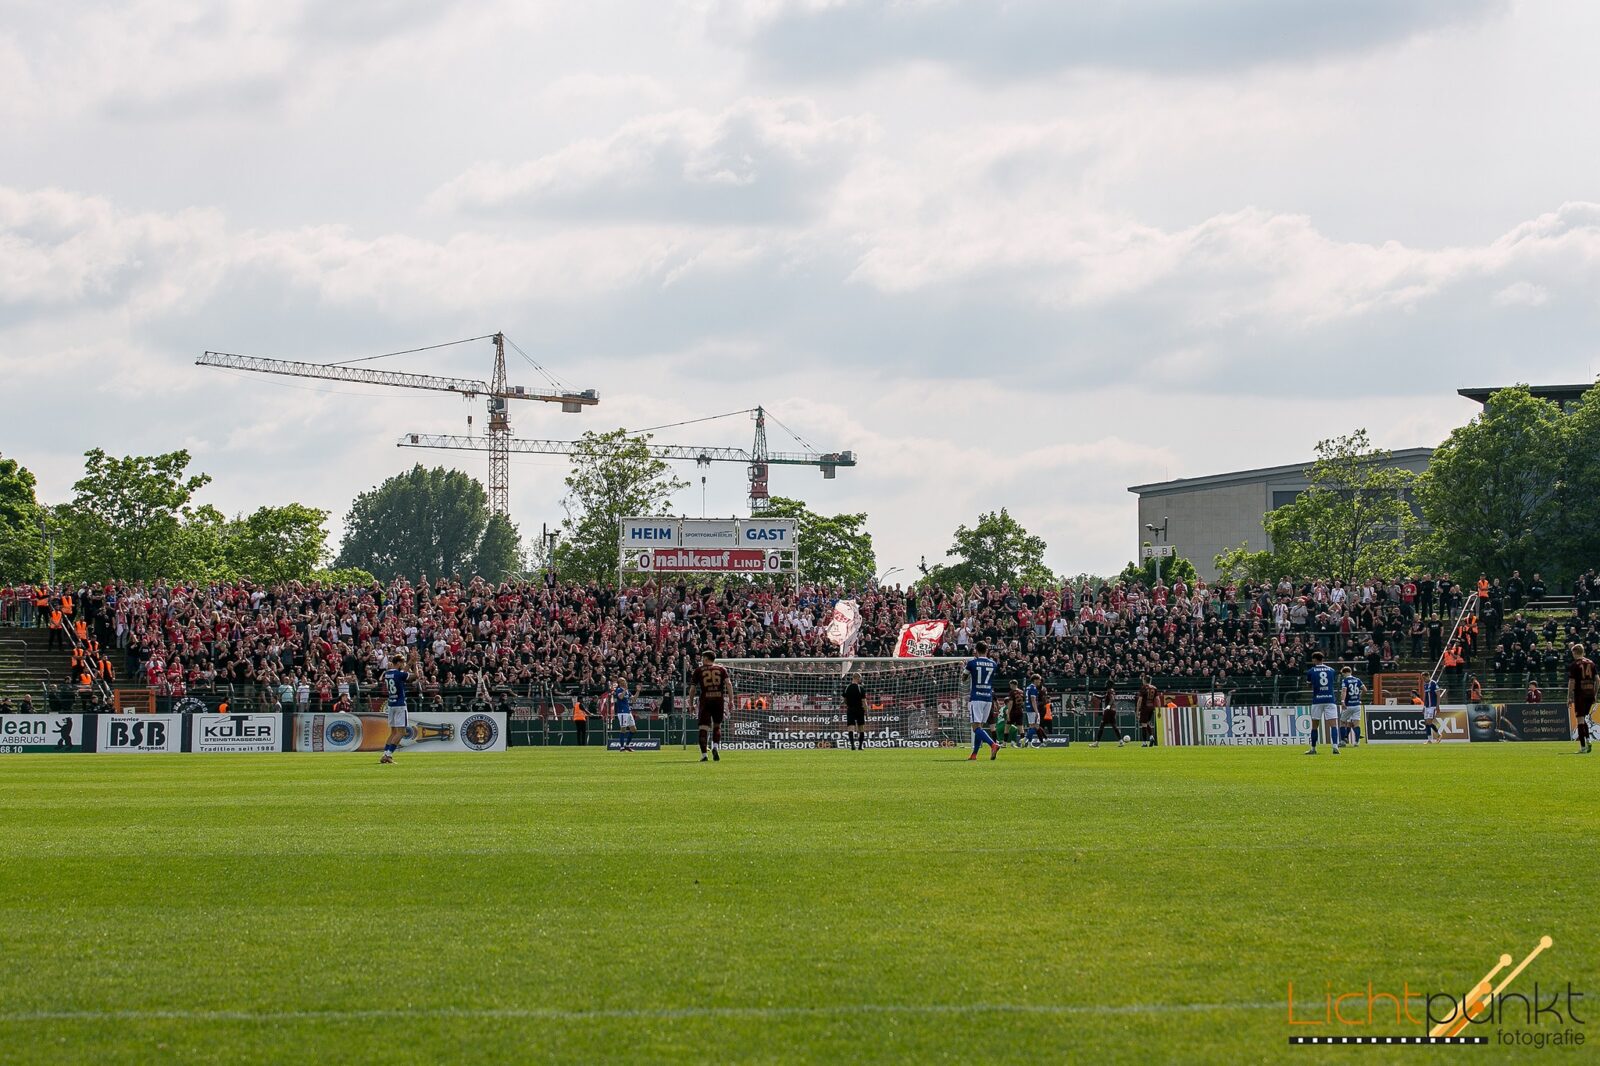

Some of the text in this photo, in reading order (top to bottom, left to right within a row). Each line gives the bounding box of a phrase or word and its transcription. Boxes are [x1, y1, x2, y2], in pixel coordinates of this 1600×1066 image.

[631, 528, 671, 540] HEIM
[746, 528, 787, 540] GAST
[639, 554, 650, 569] 0
[656, 551, 761, 568] nahkauf LIND
[768, 555, 779, 569] 0
[702, 670, 721, 687] 26
[975, 667, 994, 684] 17
[1319, 671, 1329, 686] 8
[1580, 664, 1593, 679] 14
[1348, 682, 1360, 696] 36
[734, 721, 761, 730] mister
[791, 714, 830, 724] Catering
[841, 713, 899, 722] Eservice
[1371, 716, 1464, 734] primus XL
[205, 716, 271, 736] KÜTER
[734, 728, 761, 736] roster
[2, 736, 46, 744] ABBRUCH
[110, 722, 166, 746] BSB
[768, 727, 899, 740] misterroser.de
[711, 740, 770, 750] isenbach
